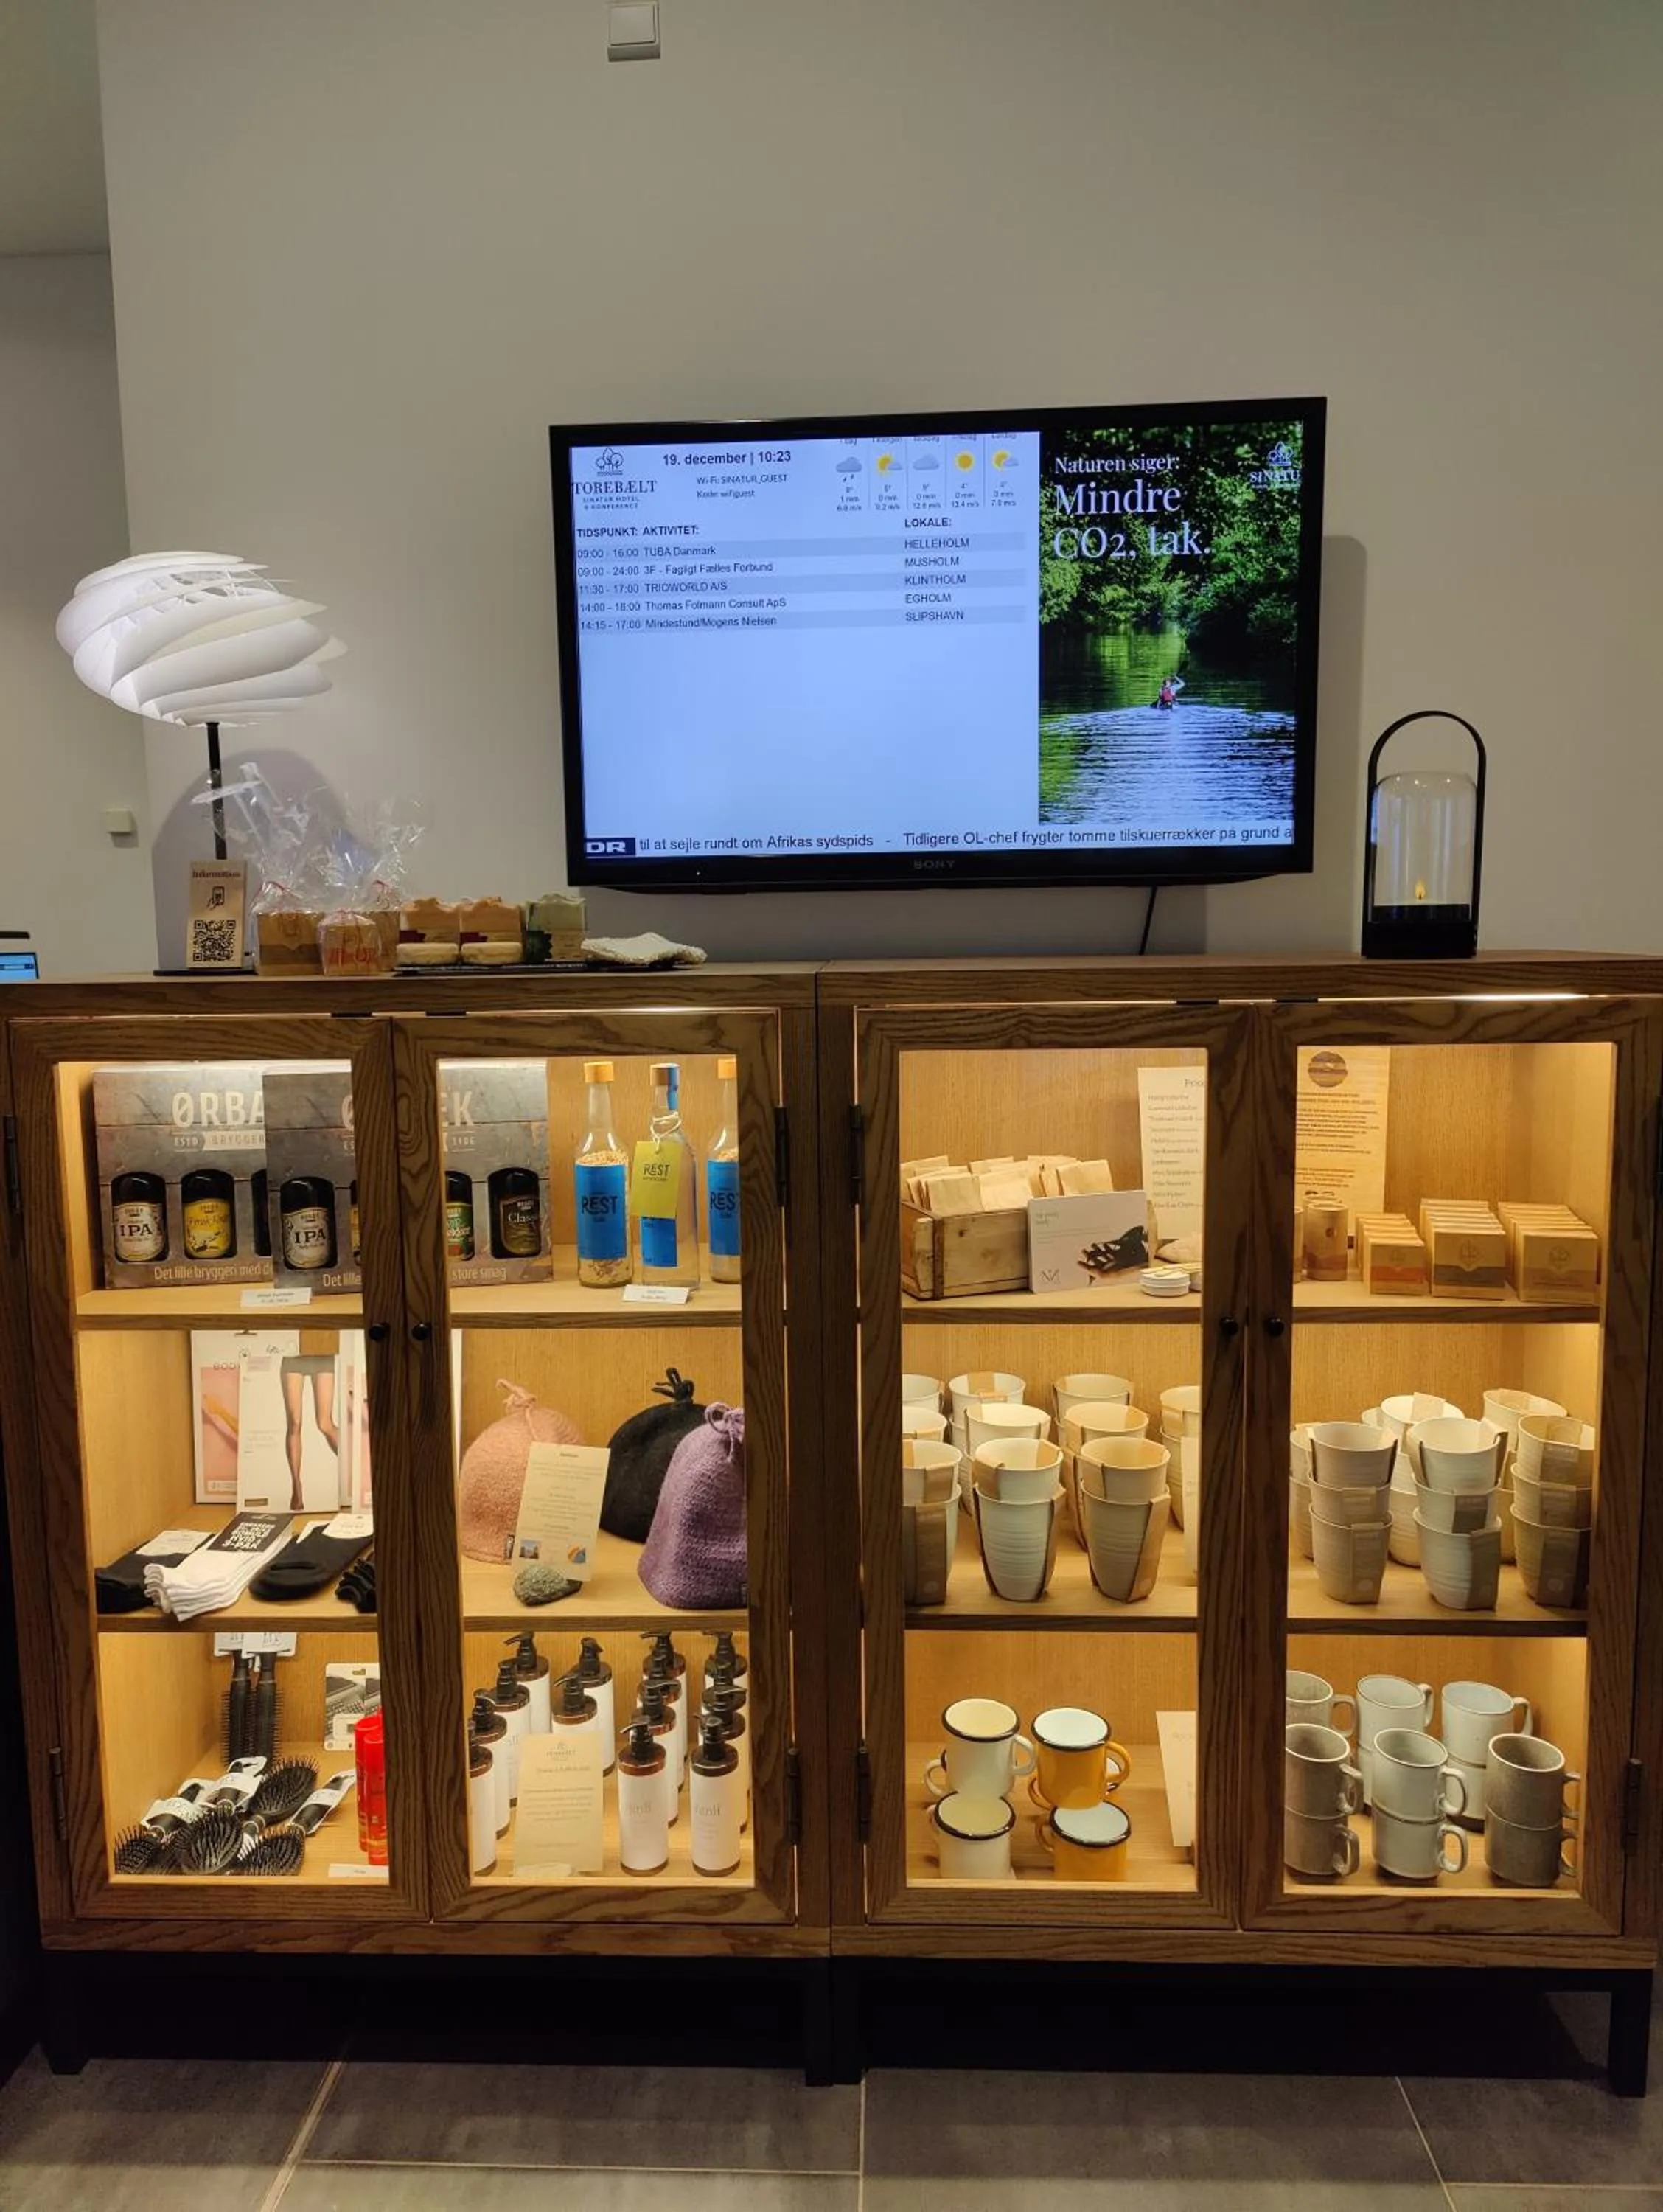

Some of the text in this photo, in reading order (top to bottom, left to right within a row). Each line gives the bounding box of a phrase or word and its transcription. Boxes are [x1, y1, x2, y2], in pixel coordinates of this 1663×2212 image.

[663, 453, 680, 466] 19.
[684, 452, 746, 465] december
[757, 451, 792, 462] 10:23
[1055, 453, 1180, 474] Naturen siger:
[1249, 469, 1300, 483] SINATU
[573, 480, 657, 494] TOREBÆLT
[1055, 479, 1181, 516] Mindre
[904, 517, 952, 528] LOKALE:
[576, 526, 700, 538] TIDSPUNKT: AKTIVITET:
[1149, 520, 1211, 556] tak.
[904, 538, 970, 549] HELLEHOLM
[577, 549, 604, 558] 09:00
[644, 546, 671, 557] TUBA
[674, 546, 717, 557] Danmark
[904, 556, 960, 567] MUSHOLM
[577, 567, 604, 577] 09:00
[613, 566, 639, 576] 24:00
[644, 566, 656, 574] 3F
[733, 562, 774, 573] Forbund
[904, 574, 966, 585] KLINTHOLM
[613, 583, 639, 594] 17:00
[644, 582, 708, 593] TRIOWORLD
[710, 581, 728, 591] A/S
[645, 601, 683, 611] Thomas
[685, 599, 726, 611] Folmann
[728, 598, 764, 608] Consult
[766, 597, 787, 609] ApS
[904, 593, 952, 604] EGHOLM
[616, 619, 641, 630] 17:00
[742, 616, 777, 626] Nielsen
[905, 610, 964, 622] SLIPSHAVN
[586, 841, 627, 853] DR
[639, 838, 649, 850] til
[654, 838, 667, 850] at
[670, 838, 700, 853] sejle
[704, 837, 738, 849] rundt
[742, 837, 763, 849] om
[767, 835, 813, 849] Afrikas
[816, 834, 874, 850] sydspids
[904, 832, 959, 847] Tidligere
[963, 831, 1018, 844] OL-chef
[1022, 831, 1064, 846] frygter
[1069, 830, 1115, 842] tomme
[1120, 828, 1215, 842] tilskuerrækker
[1219, 827, 1236, 841] på
[1241, 827, 1280, 841] grund
[1283, 827, 1293, 838] a
[211, 1134, 266, 1146] BRYGGER
[644, 1164, 669, 1177] REST
[581, 1195, 618, 1215] REST
[710, 1192, 737, 1211] RES
[120, 1223, 153, 1237] IPA
[295, 1228, 325, 1244] IPA
[154, 1266, 172, 1279] Det
[240, 1263, 261, 1276] med
[323, 1273, 342, 1287] Det
